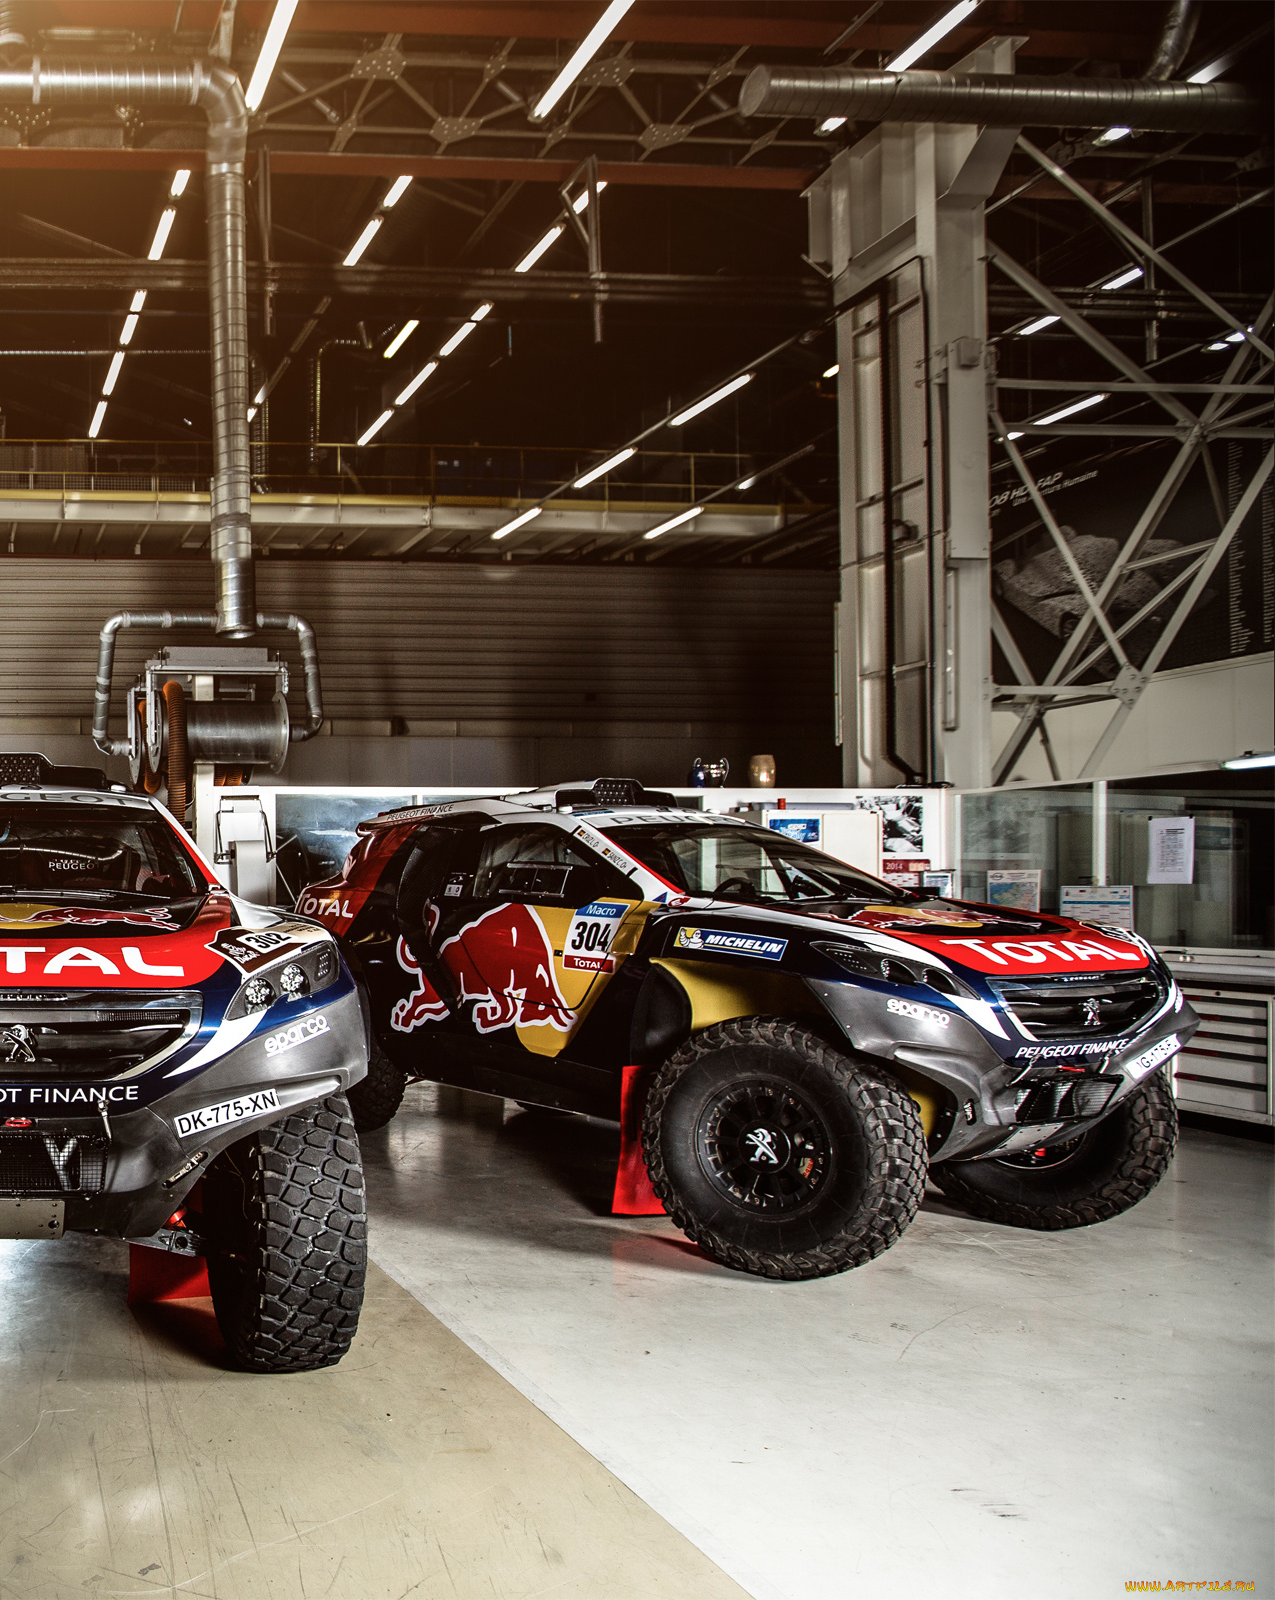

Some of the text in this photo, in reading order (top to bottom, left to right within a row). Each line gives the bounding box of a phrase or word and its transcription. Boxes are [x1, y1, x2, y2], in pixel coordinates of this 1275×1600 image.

[1063, 469, 1099, 488] Humaine
[990, 491, 1010, 509] 08
[1036, 472, 1063, 488] FAP
[387, 804, 454, 821] PEUGEOT FINANCE
[886, 862, 903, 870] 2014
[299, 893, 354, 919] TOTAL
[587, 904, 616, 916] Macro
[245, 932, 292, 949] 302
[571, 921, 611, 952] 304
[705, 934, 783, 954] MICHELIN
[939, 938, 1141, 965] TOTAL
[573, 956, 603, 969] TOTAL
[887, 998, 951, 1028] sparco
[265, 1013, 329, 1054] sparco
[1015, 1037, 1129, 1059] PEUGEOT FINANCE
[30, 1085, 139, 1103] FINANCE
[177, 1092, 277, 1136] DK-775-XN
